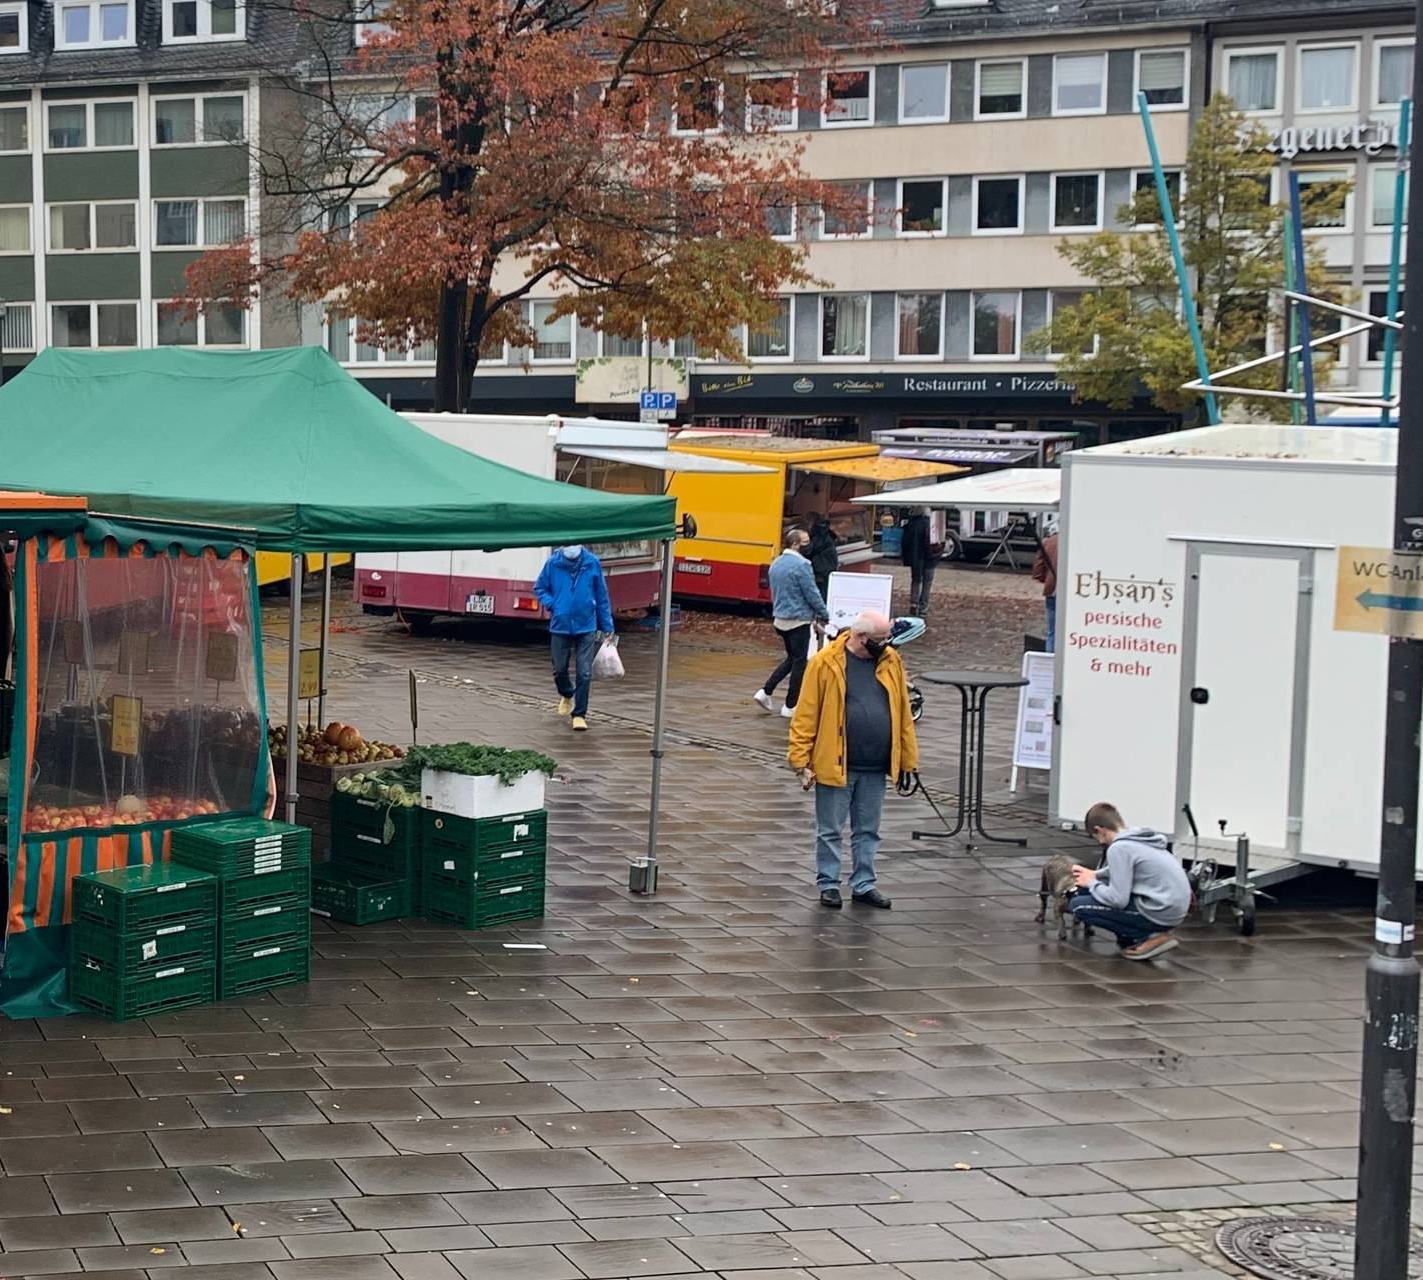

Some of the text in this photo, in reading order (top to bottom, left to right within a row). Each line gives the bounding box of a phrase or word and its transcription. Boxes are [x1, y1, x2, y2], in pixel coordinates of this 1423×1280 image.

[904, 377, 987, 391] Restaurant
[1353, 561, 1423, 580] WC-Anl
[1075, 571, 1175, 608] Ehsan's
[1084, 609, 1163, 630] persische
[1068, 632, 1178, 656] Spezialitäten
[1090, 657, 1152, 677] & mehr
